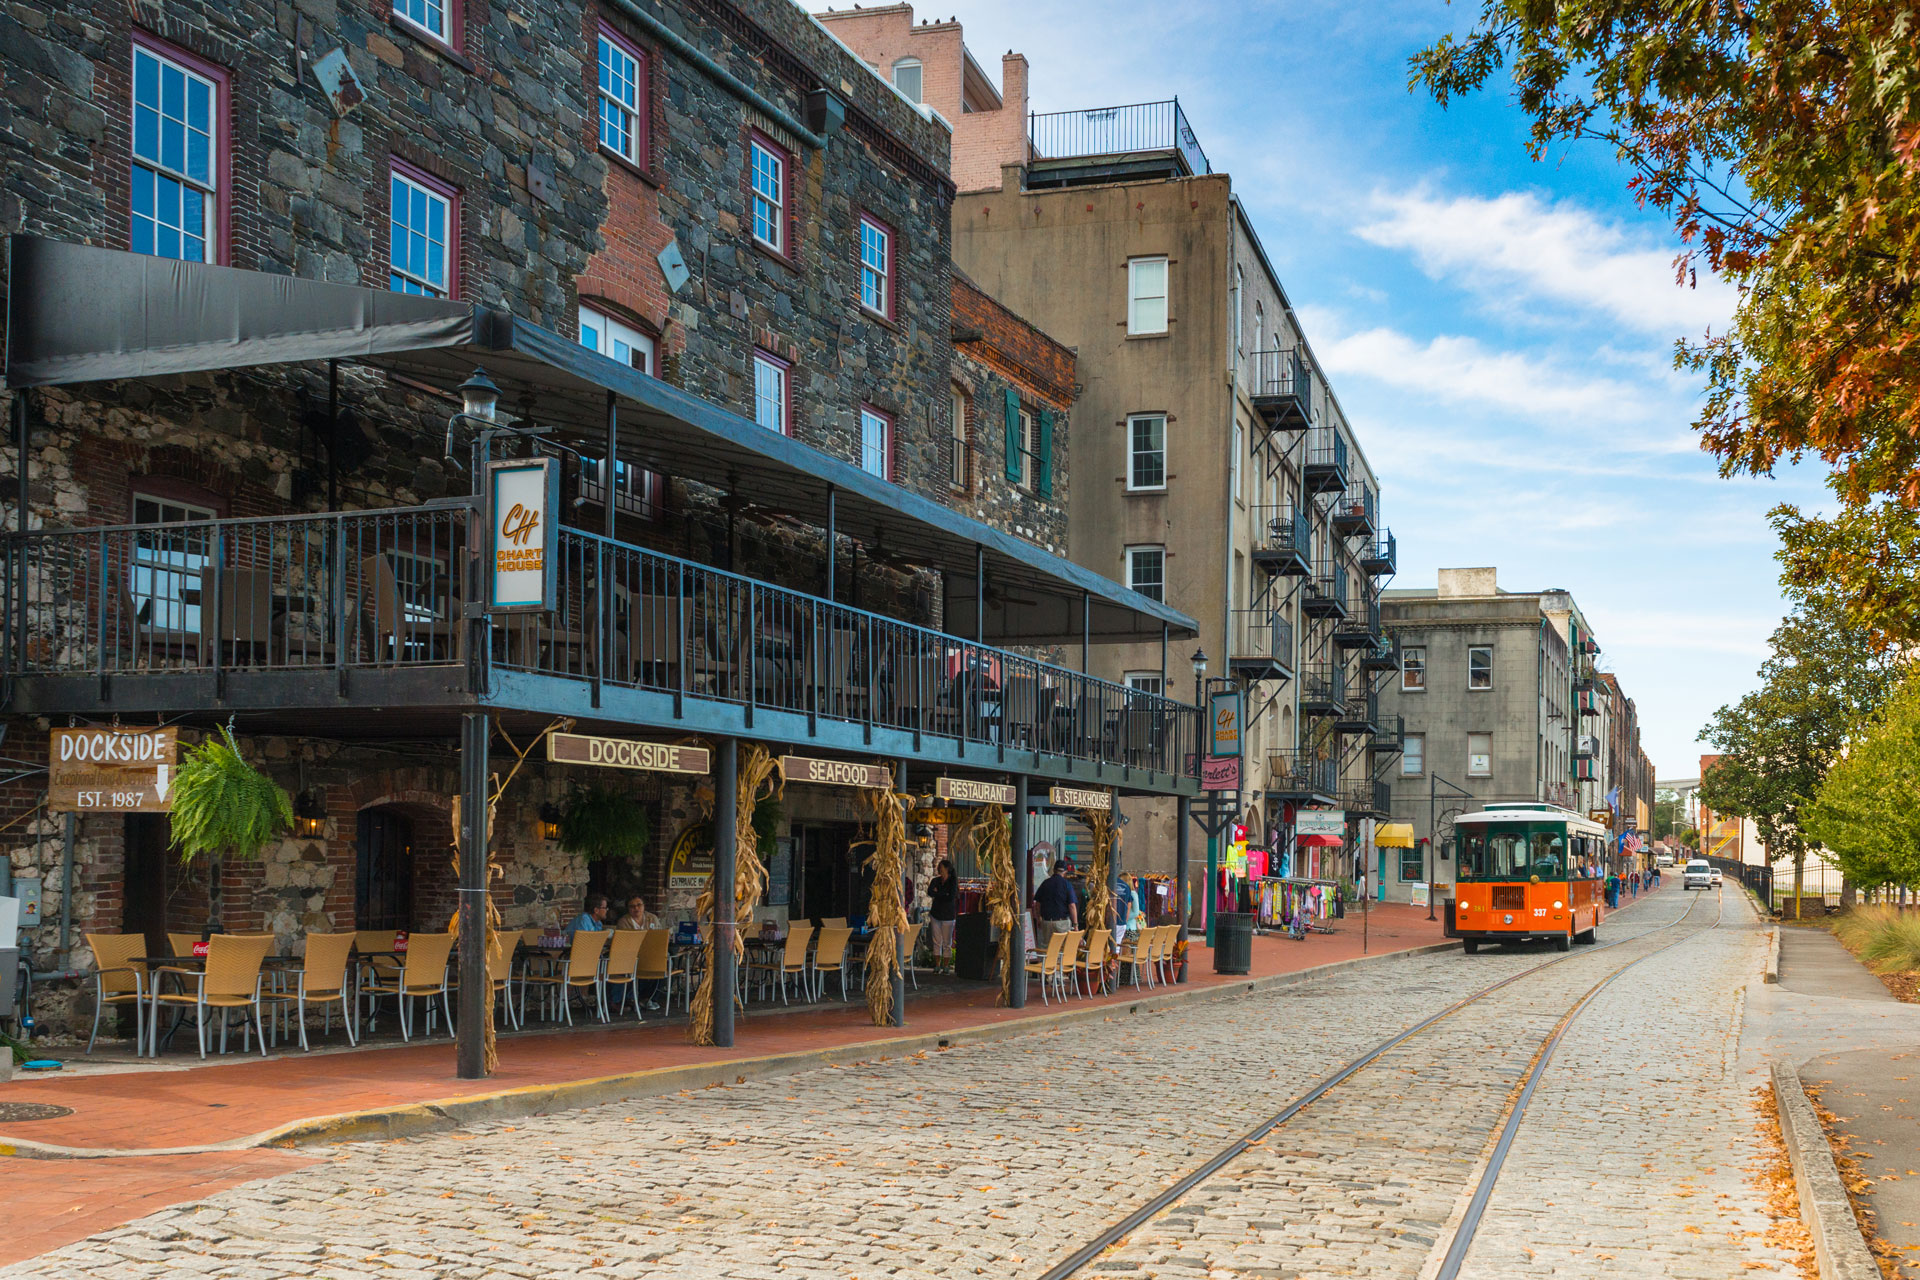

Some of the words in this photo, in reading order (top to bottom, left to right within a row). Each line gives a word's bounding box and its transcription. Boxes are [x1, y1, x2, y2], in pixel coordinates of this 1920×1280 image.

[502, 503, 540, 546] CH
[496, 548, 543, 560] CHART
[496, 559, 543, 572] HOUSE
[60, 732, 166, 762] DOCKSIDE
[589, 739, 680, 769] DOCKSIDE
[808, 761, 869, 785] SEAFOOD
[77, 791, 107, 807] EST.
[111, 792, 144, 807] 1987
[950, 781, 1008, 802] RESTAURANT
[1055, 790, 1062, 802] &
[1064, 790, 1109, 807] STEAKHOUSE
[1533, 908, 1548, 917] 337
